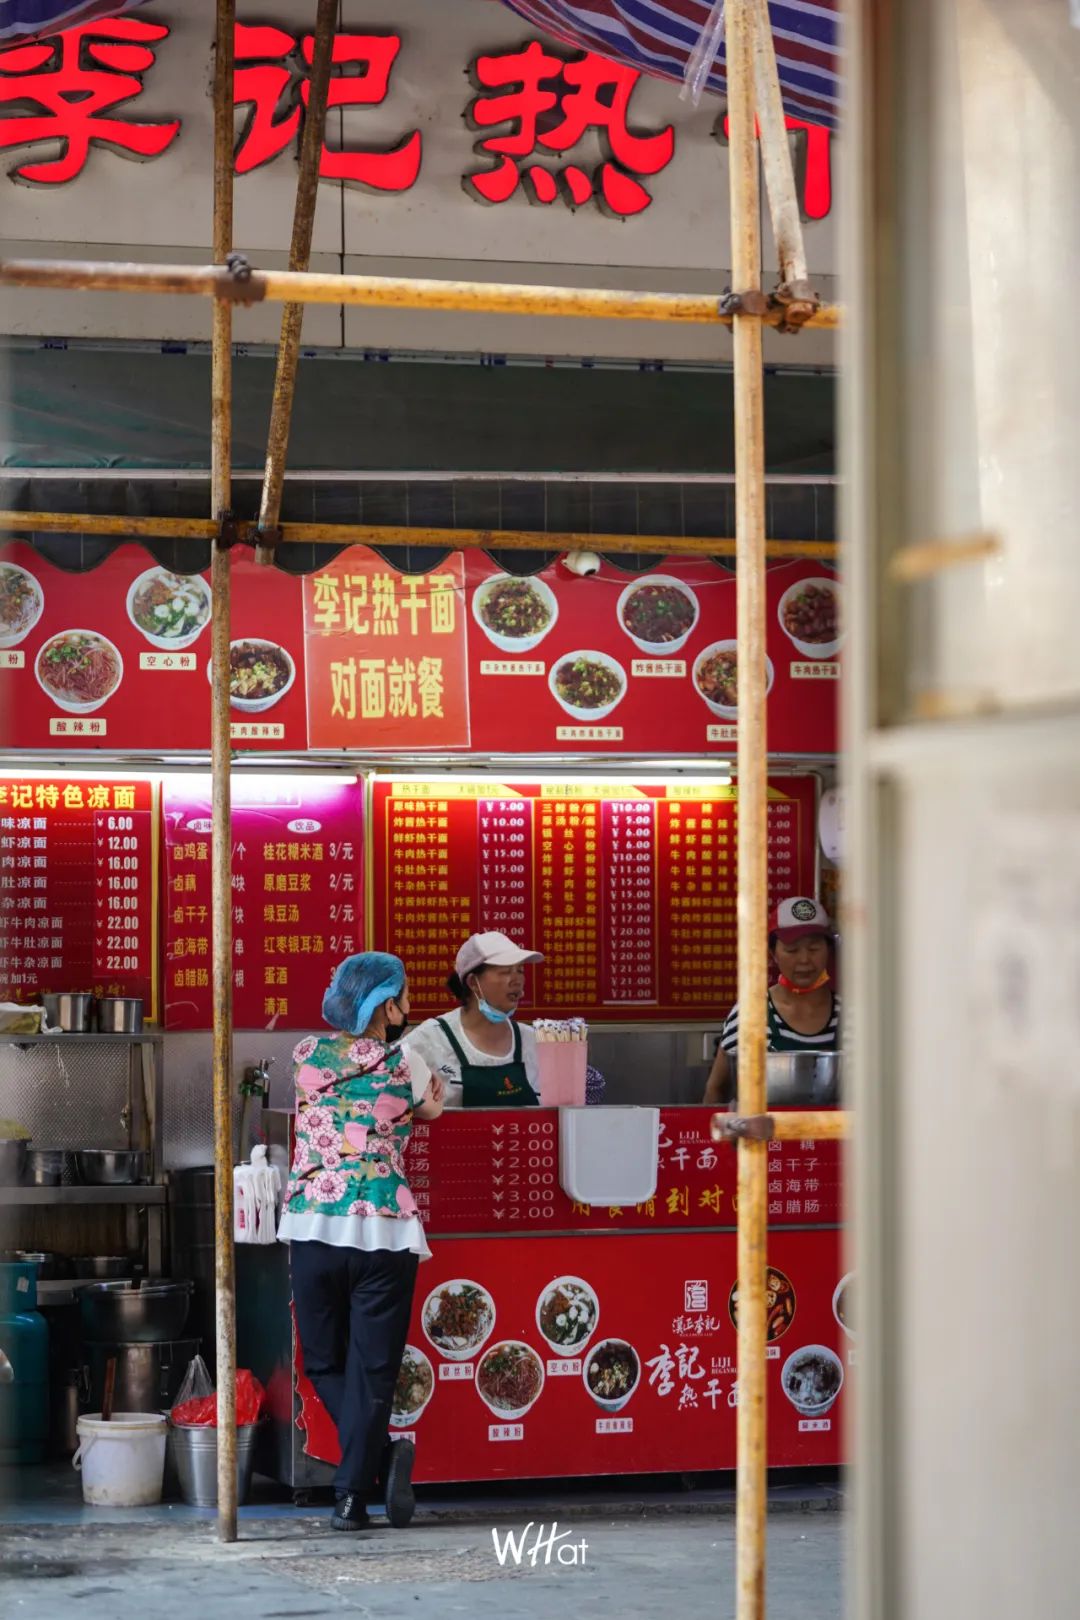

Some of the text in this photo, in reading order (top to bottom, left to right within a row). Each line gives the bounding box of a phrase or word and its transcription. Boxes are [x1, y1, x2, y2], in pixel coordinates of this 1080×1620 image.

[313, 573, 455, 636] 李记热干面
[146, 656, 191, 667] 空心粉
[330, 656, 444, 720] 对面就餐
[56, 721, 100, 733] 酸辣粉
[295, 821, 315, 831] 饮品
[173, 842, 208, 860] 卤鸡蛋
[393, 849, 448, 859] 牛肉热干面
[393, 865, 448, 875] 牛肚热干面
[263, 874, 311, 892] 原磨豆浆
[173, 906, 208, 923] 卤干子
[263, 904, 299, 922] 绿豆汤
[174, 937, 208, 955] 卤海带
[263, 935, 324, 953] 红枣银耳汤
[174, 968, 208, 987] 卤腊肠
[264, 966, 288, 985] 蛋酒
[410, 1141, 430, 1155] 浆
[409, 1158, 430, 1172] 汤
[657, 1147, 718, 1171] 干面
[768, 1158, 819, 1172] 卤干子
[768, 1178, 819, 1193] 卤海带
[768, 1199, 820, 1214] 卤腊肠
[711, 1356, 731, 1368] LIJI
